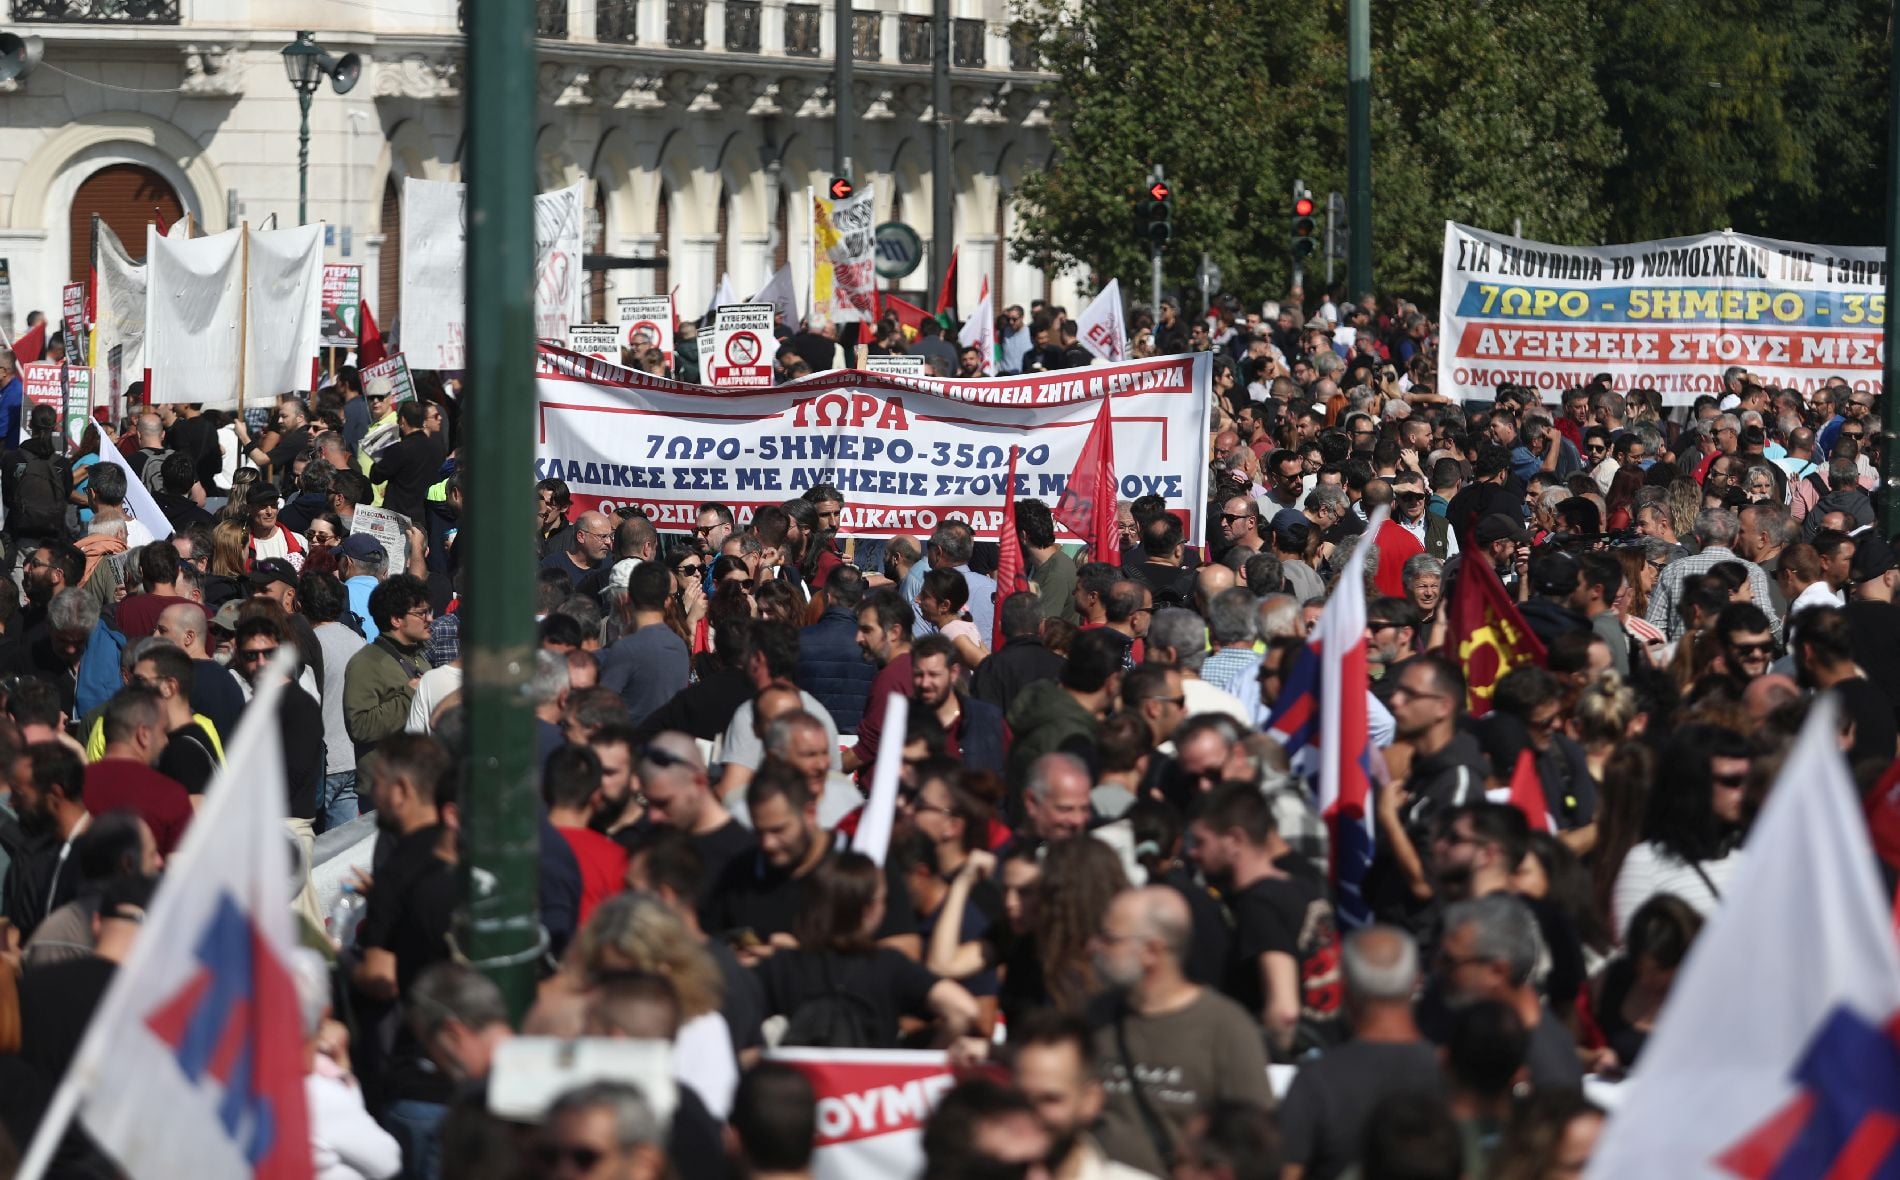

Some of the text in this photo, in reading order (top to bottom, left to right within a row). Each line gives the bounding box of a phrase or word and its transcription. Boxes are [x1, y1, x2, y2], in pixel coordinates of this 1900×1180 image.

[1457, 239, 1491, 272] ΣΤΑ
[1498, 243, 1602, 281] ΣΚΟΥΠΙΔΙΑ
[1610, 256, 1634, 279] ΤΟ
[1641, 244, 1769, 278] ΝΟΜΟΣΧΕΔΙΟ
[1779, 249, 1814, 282] ΤΗΣ
[722, 314, 768, 322] ΚΥΒΕΡΝΗΣΗ
[1480, 285, 1589, 317] 7ΩΡΟ
[1627, 289, 1804, 322] 5ΗΜΕΡΟ
[1476, 328, 1659, 358] ΑΥΞΗΣΕΙΣ
[1669, 333, 1790, 362] ΣΤΟΥΣ
[27, 367, 89, 382] ΛΕΥΤΡΙΑ
[1036, 380, 1085, 403] ΖΗΤΑ
[1089, 376, 1104, 397] Η
[792, 394, 908, 430] ΤΩΡΑ
[672, 467, 728, 490] ΣΣΕ
[736, 467, 782, 490] ΜΕ
